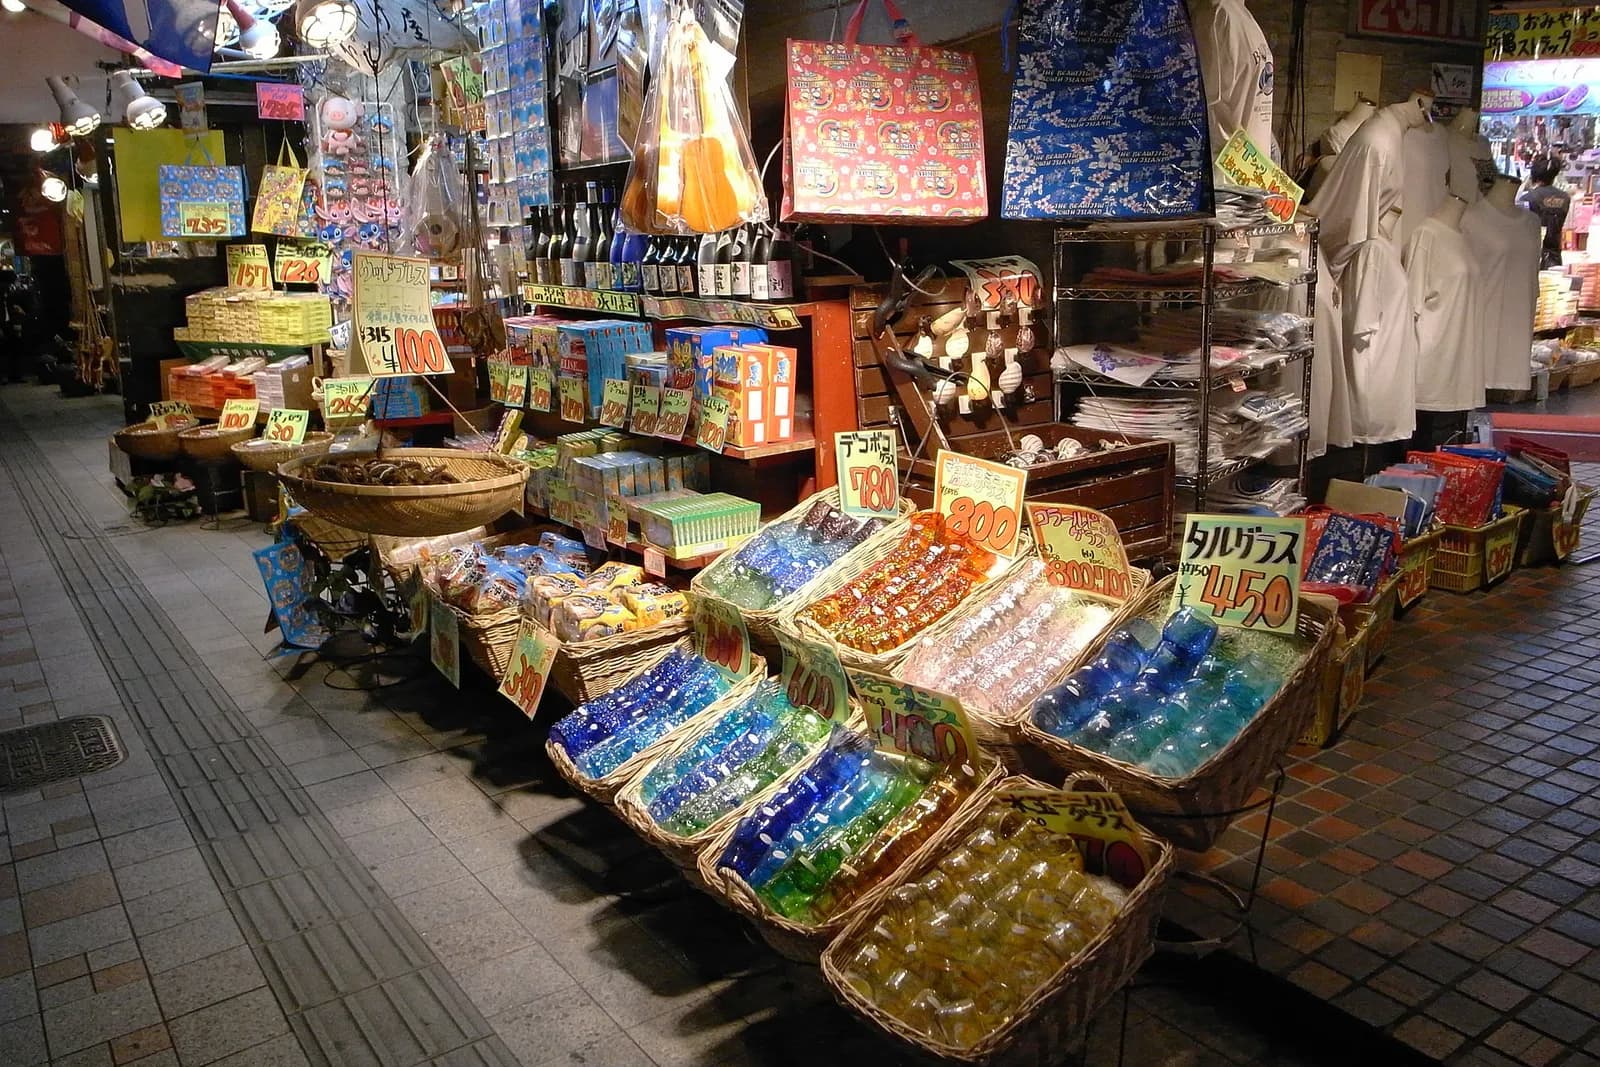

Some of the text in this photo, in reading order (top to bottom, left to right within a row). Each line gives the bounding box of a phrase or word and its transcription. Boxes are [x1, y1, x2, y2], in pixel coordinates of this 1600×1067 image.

[840, 432, 891, 458] デコボコ
[849, 465, 896, 512] 780
[946, 496, 1017, 550] 800
[1186, 521, 1299, 564] タルグラス
